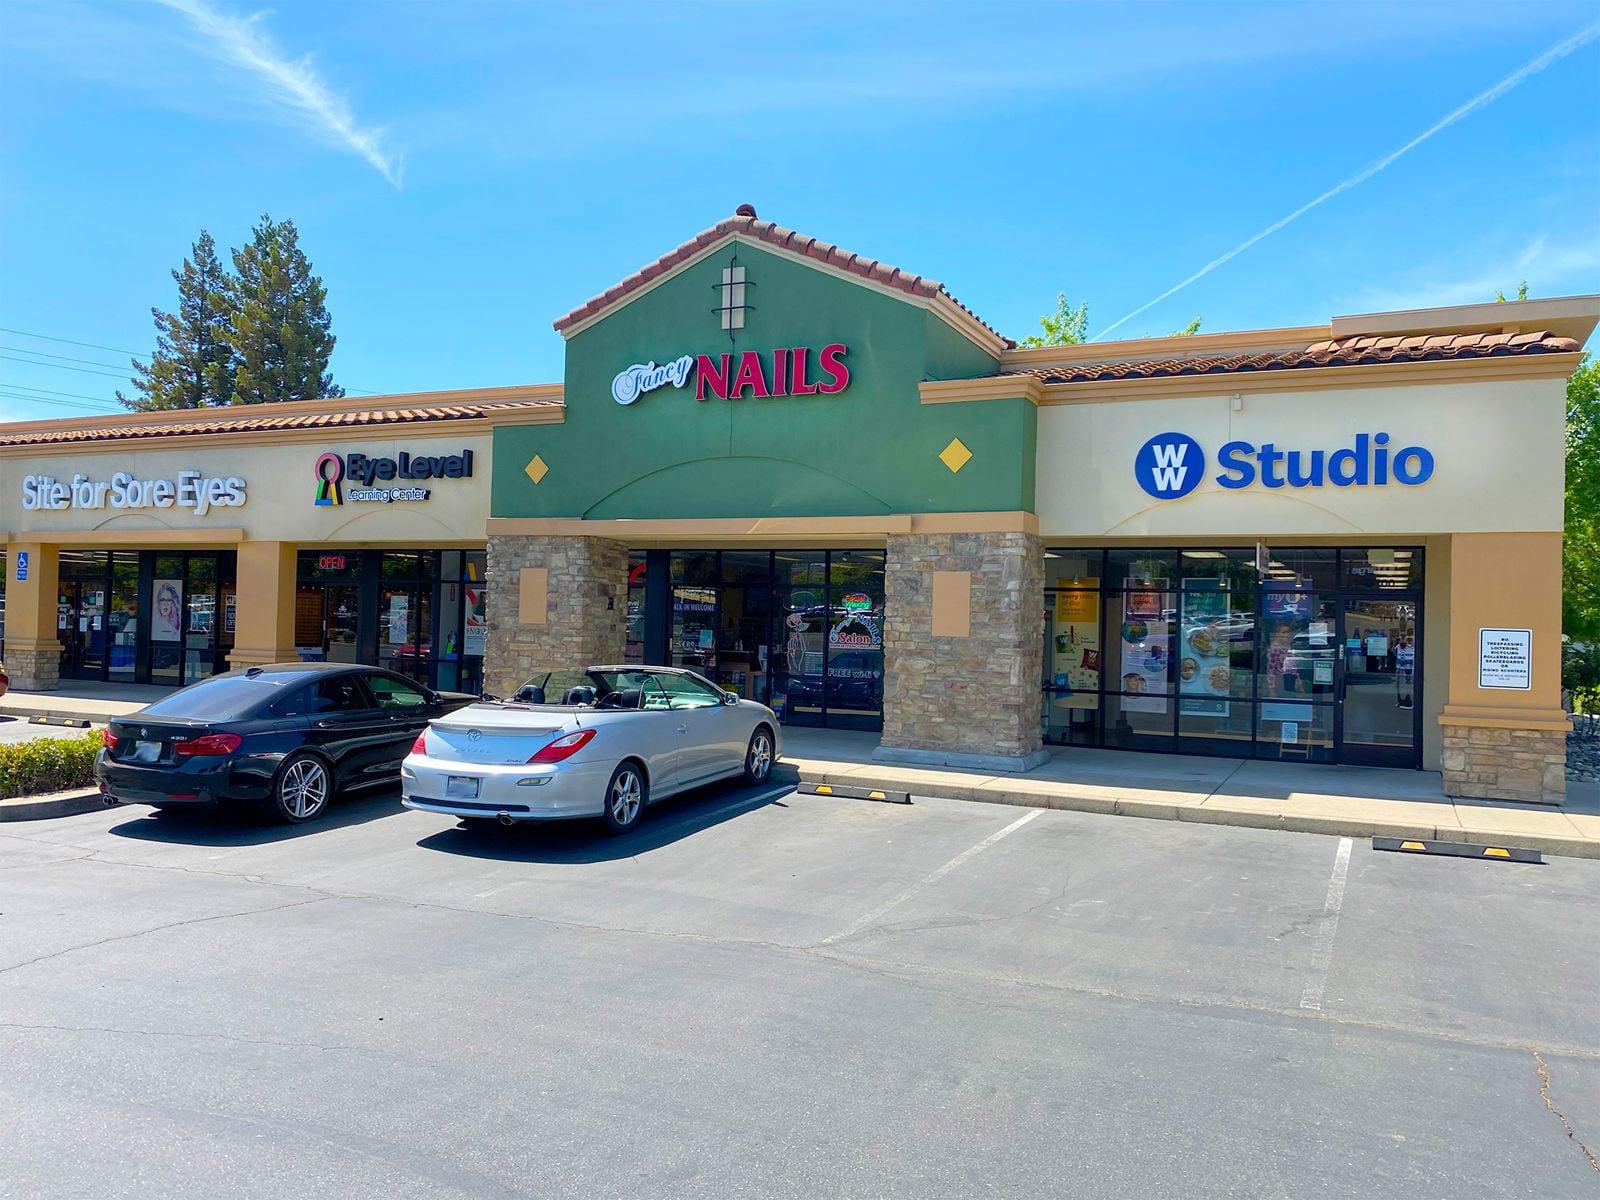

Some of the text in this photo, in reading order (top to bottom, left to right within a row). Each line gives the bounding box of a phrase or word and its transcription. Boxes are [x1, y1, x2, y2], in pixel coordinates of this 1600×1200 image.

[611, 343, 850, 405] Fancy NAILS
[347, 449, 474, 486] Eye Level
[1215, 432, 1434, 489] Studio
[22, 470, 247, 516] Site for Sore Eyes
[347, 488, 431, 503] Learning Center
[319, 556, 345, 569] OPEN
[839, 632, 871, 644] Salon
[855, 613, 881, 644] NAILS
[828, 668, 851, 677] FREE
